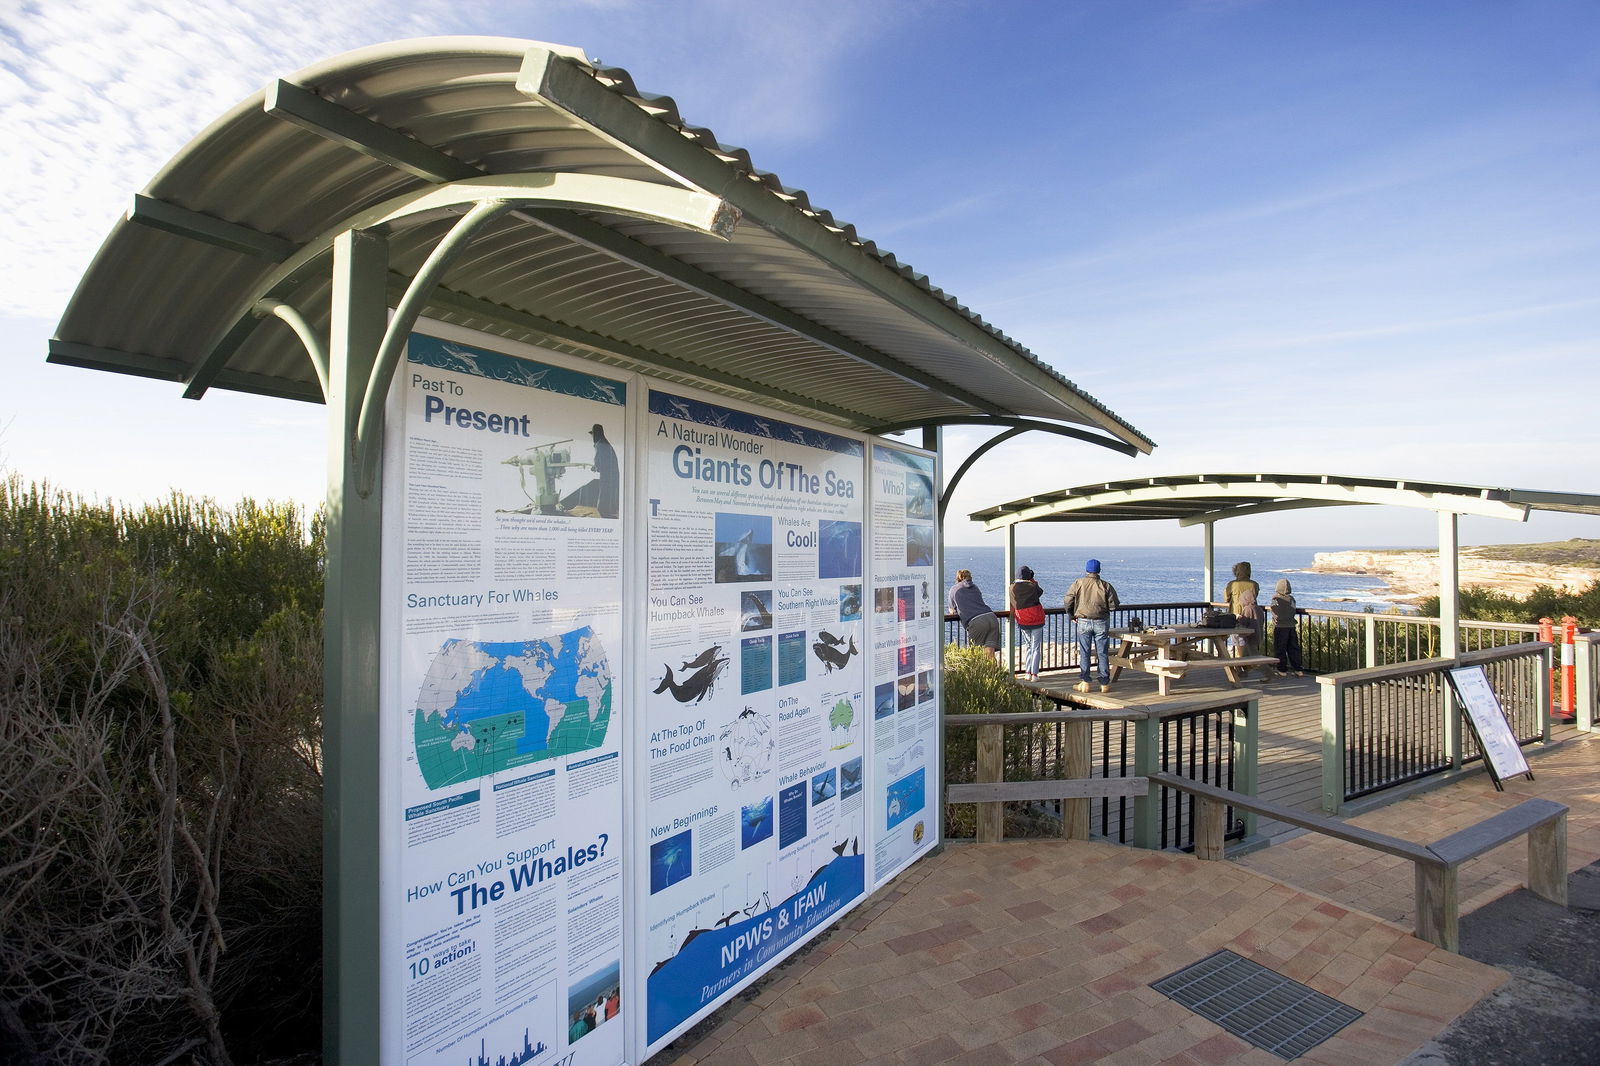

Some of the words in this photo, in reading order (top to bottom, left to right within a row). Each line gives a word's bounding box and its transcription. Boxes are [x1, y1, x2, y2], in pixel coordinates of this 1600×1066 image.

[412, 374, 445, 393] Past
[447, 380, 465, 397] To
[425, 395, 532, 438] Present
[657, 420, 669, 438] A
[672, 422, 719, 448] Natural
[720, 433, 764, 455] Wonder
[672, 444, 753, 486] Giants
[758, 459, 785, 490] Of
[785, 463, 821, 495] The
[825, 470, 855, 499] Sea
[882, 479, 906, 496] Who?
[778, 516, 797, 528] Whales
[798, 517, 812, 528] Are
[786, 529, 818, 548] Cool!
[407, 593, 484, 608] Sanctuary
[488, 590, 511, 604] For
[512, 588, 560, 603] Whales
[650, 595, 669, 607] You
[670, 594, 687, 606] Can
[688, 594, 704, 605] See
[778, 588, 790, 599] You
[790, 588, 803, 598] Can
[802, 588, 814, 597] See
[778, 598, 805, 611] Southern
[804, 598, 820, 610] Right
[819, 596, 839, 608] Whales
[650, 606, 695, 622] Humpback
[696, 605, 726, 619] Whales
[778, 698, 788, 709] On
[787, 697, 799, 707] The
[778, 712, 794, 722] Road
[793, 705, 812, 720] Again
[650, 731, 662, 744] At
[661, 726, 678, 740] The
[678, 723, 695, 739] Top
[696, 719, 707, 730] Of
[650, 746, 668, 760] The
[670, 740, 692, 756] Food
[693, 733, 716, 749] Chain
[778, 773, 799, 787] Whale
[799, 760, 827, 778] Behaviour
[650, 823, 671, 839] New
[673, 804, 719, 829] Beginnings
[407, 879, 444, 903] How
[447, 868, 476, 887] Can
[476, 857, 503, 876] You
[506, 837, 557, 866] Support
[450, 880, 506, 916] The
[509, 833, 610, 892] Whales?
[721, 917, 774, 968] NPWS
[778, 908, 791, 930] &
[793, 881, 829, 919] IFAW
[433, 948, 451, 959] ways
[459, 938, 473, 948] take
[434, 940, 477, 969] action!
[700, 968, 743, 1002] Partners
[743, 957, 755, 973] in
[756, 925, 807, 963] Community
[805, 898, 842, 928] Education
[408, 957, 431, 980] 10
